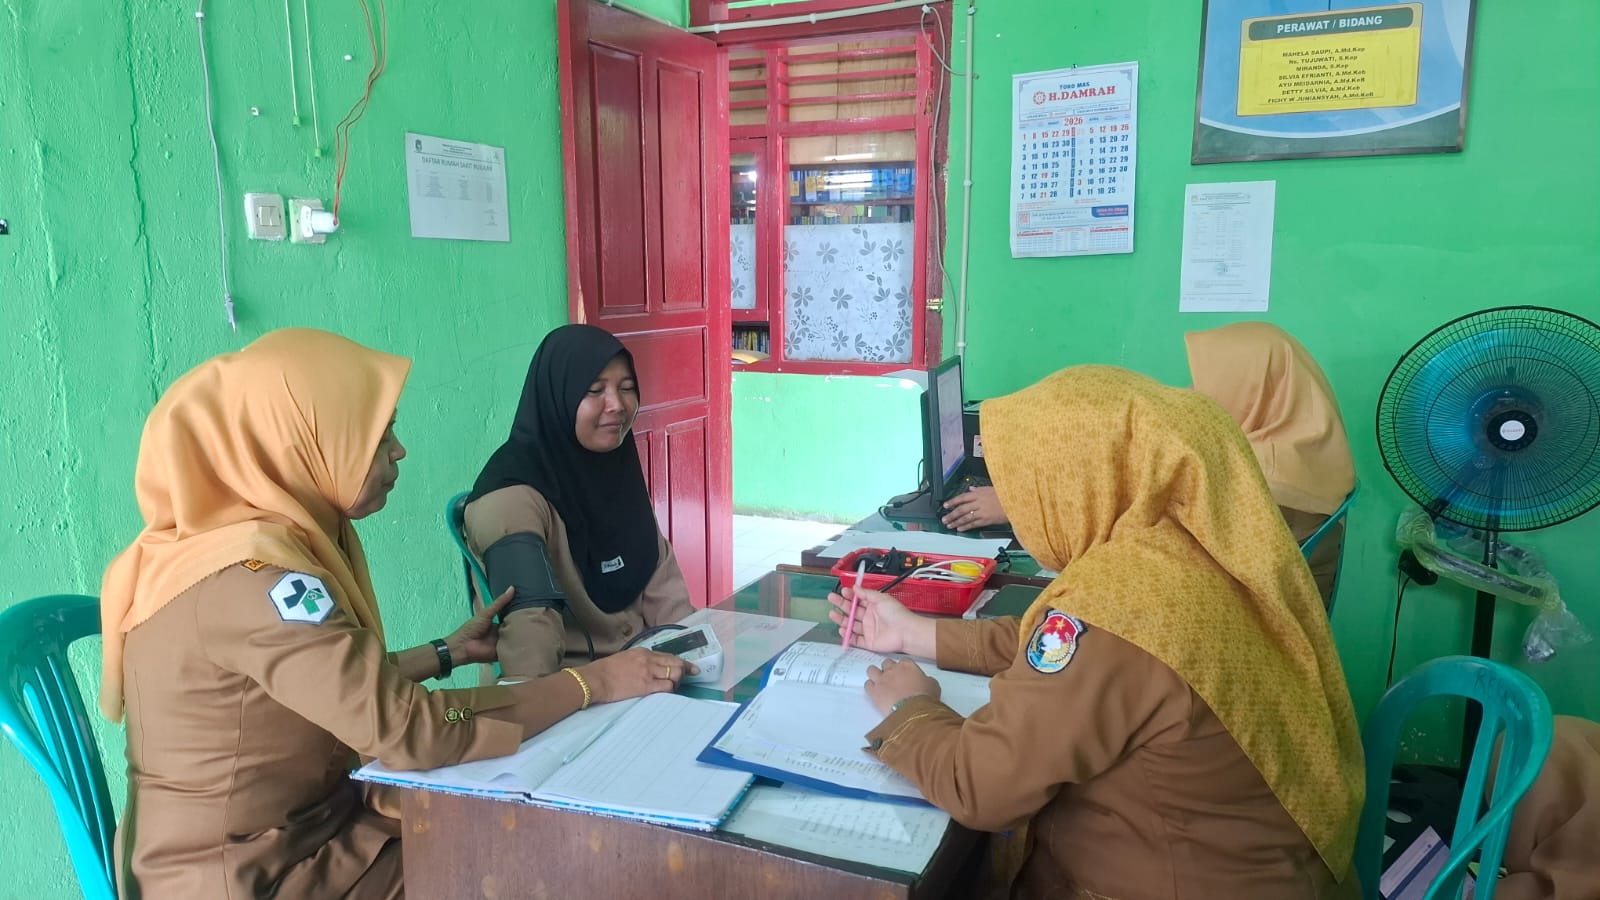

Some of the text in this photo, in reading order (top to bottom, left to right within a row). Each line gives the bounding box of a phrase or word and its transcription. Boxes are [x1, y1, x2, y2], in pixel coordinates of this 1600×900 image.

[1277, 16, 1383, 33] PERAWAT / BIDANG
[1049, 86, 1116, 101] H.DAMRAH
[1064, 117, 1083, 126] 2026
[441, 159, 459, 168] RUMAH
[1108, 186, 1116, 194] 25
